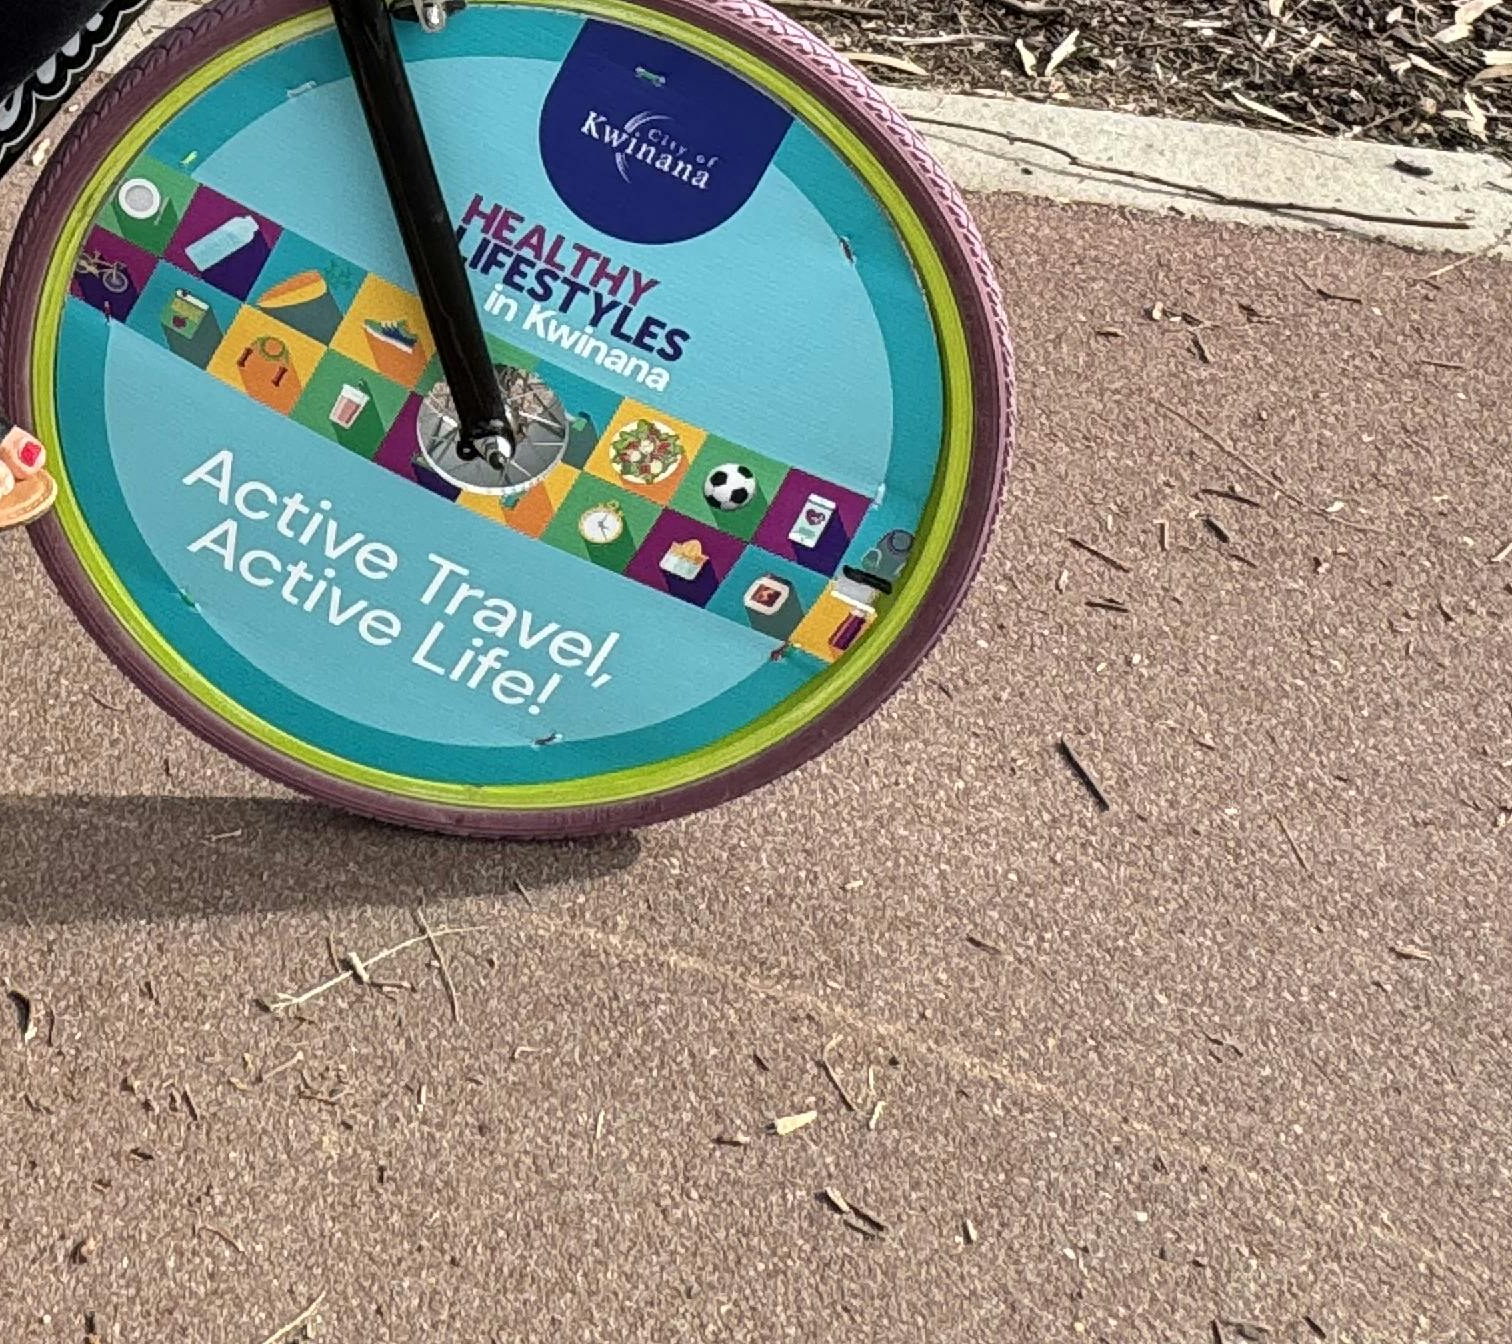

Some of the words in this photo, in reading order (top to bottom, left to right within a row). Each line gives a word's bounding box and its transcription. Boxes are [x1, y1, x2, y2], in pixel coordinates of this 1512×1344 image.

[580, 111, 710, 189] Kwinana
[648, 128, 688, 156] City
[696, 154, 720, 168] of
[461, 193, 661, 307] HEALTHY
[483, 283, 518, 322] in
[522, 302, 670, 392] Kwinana
[182, 449, 399, 581] Active
[419, 553, 620, 688] Travel,
[186, 518, 402, 646] Active
[412, 621, 563, 715] Life!
